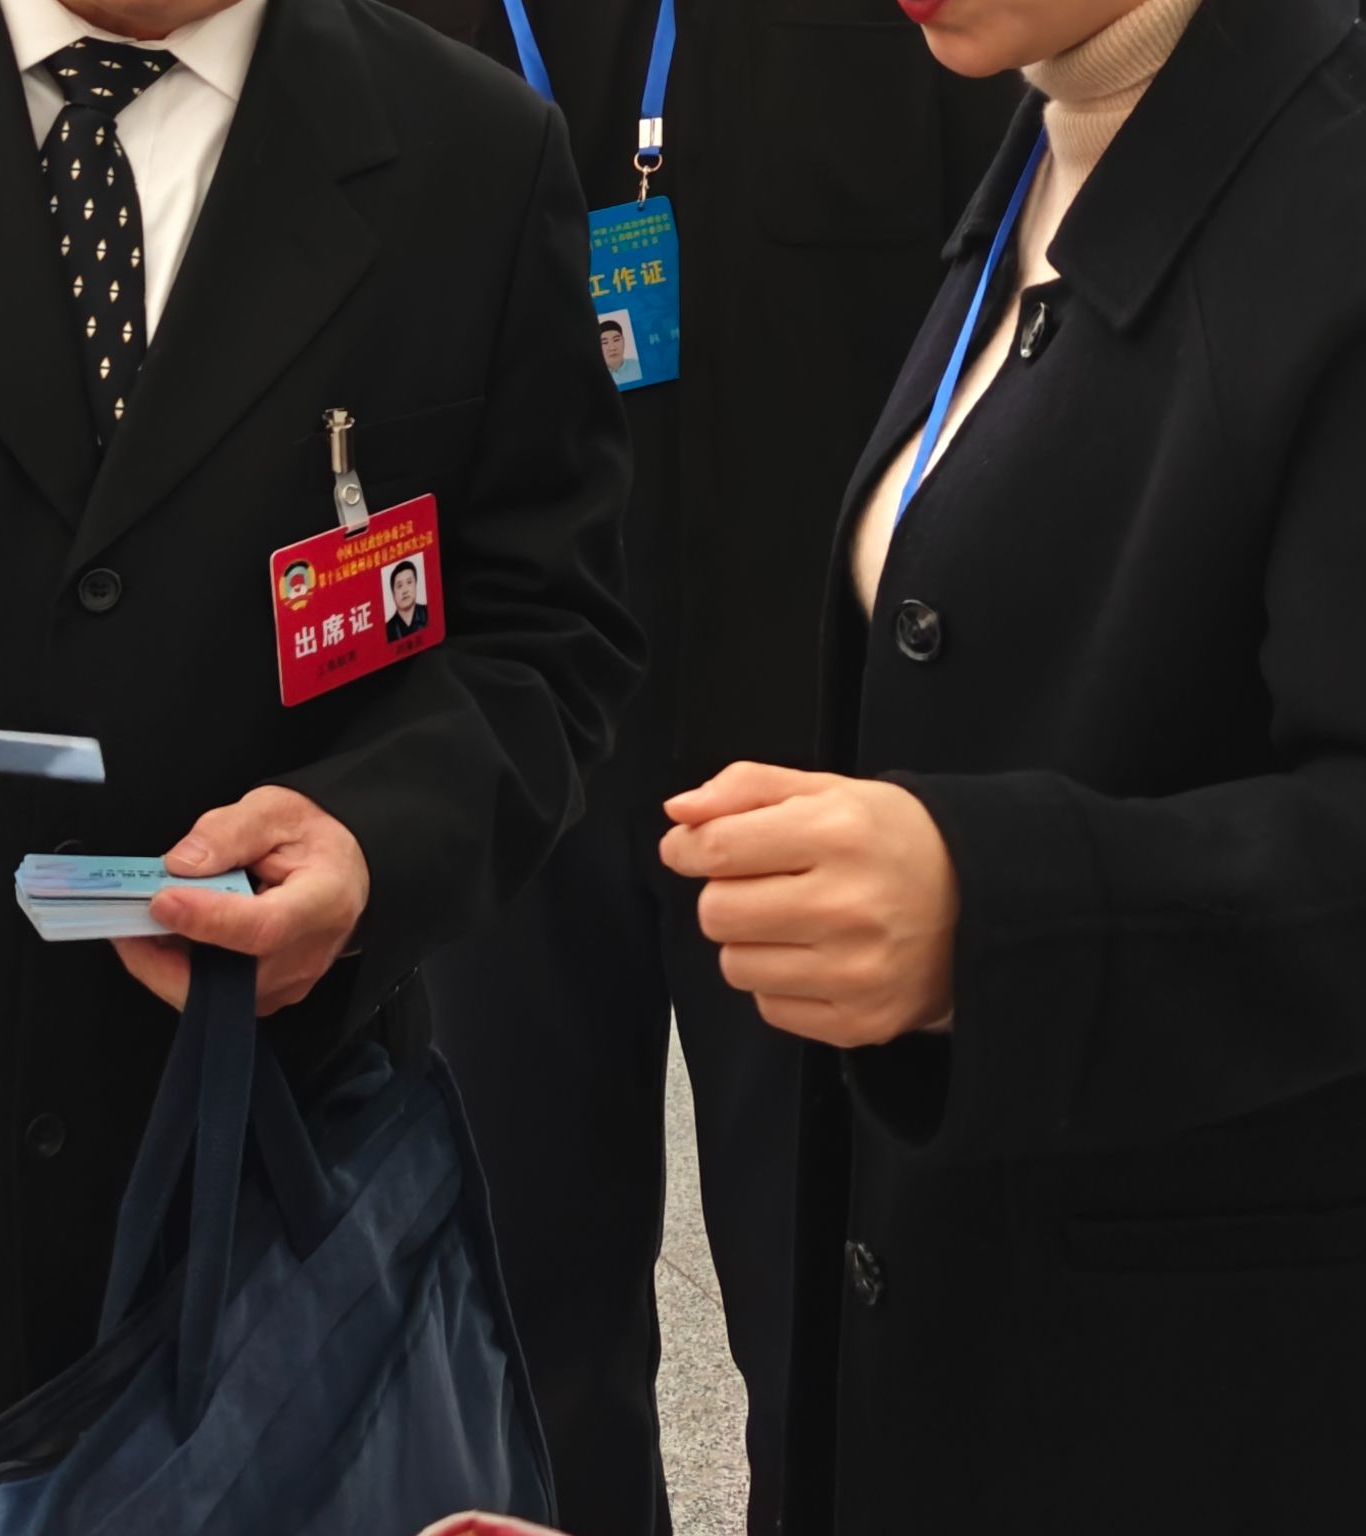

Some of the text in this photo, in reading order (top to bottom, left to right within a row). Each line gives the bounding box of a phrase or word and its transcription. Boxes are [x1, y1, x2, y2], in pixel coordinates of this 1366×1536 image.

[589, 260, 667, 297] 工作证
[294, 601, 374, 659] 出席证
